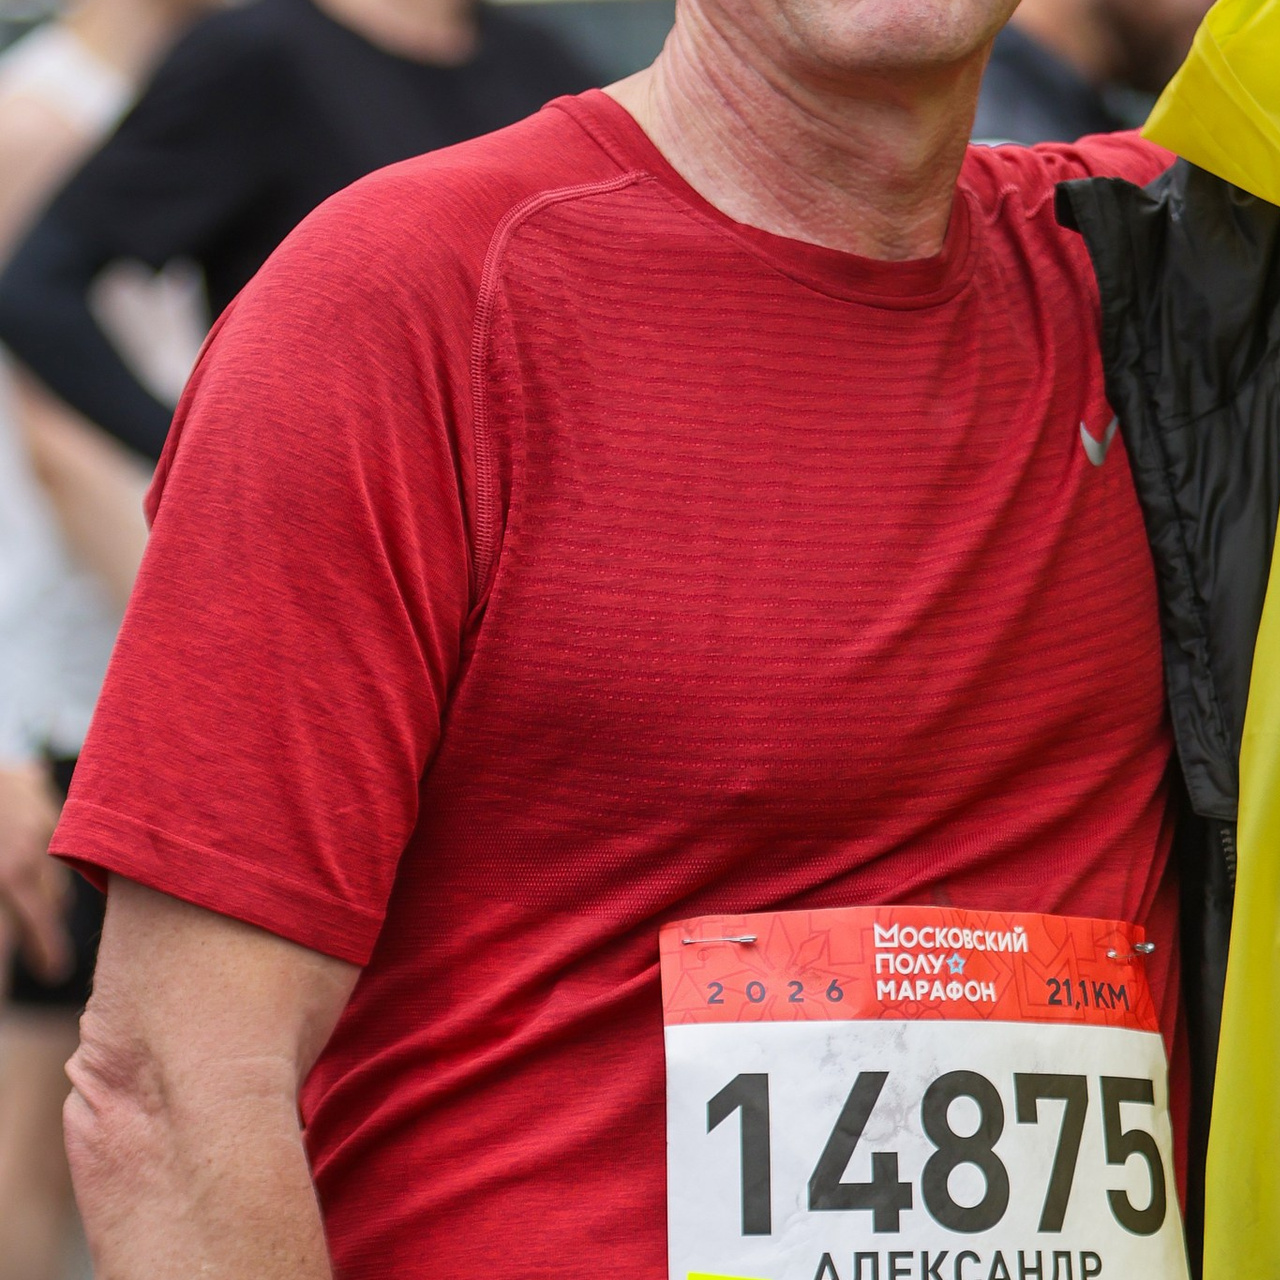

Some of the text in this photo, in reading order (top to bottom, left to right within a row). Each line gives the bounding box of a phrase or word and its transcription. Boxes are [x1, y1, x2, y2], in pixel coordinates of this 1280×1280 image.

[873, 923, 1028, 953] МОСКОВСКИЙ
[876, 953, 946, 975] ПОЛУ
[877, 980, 996, 1002] МАРАФОН
[706, 1070, 1167, 1237] 14875
